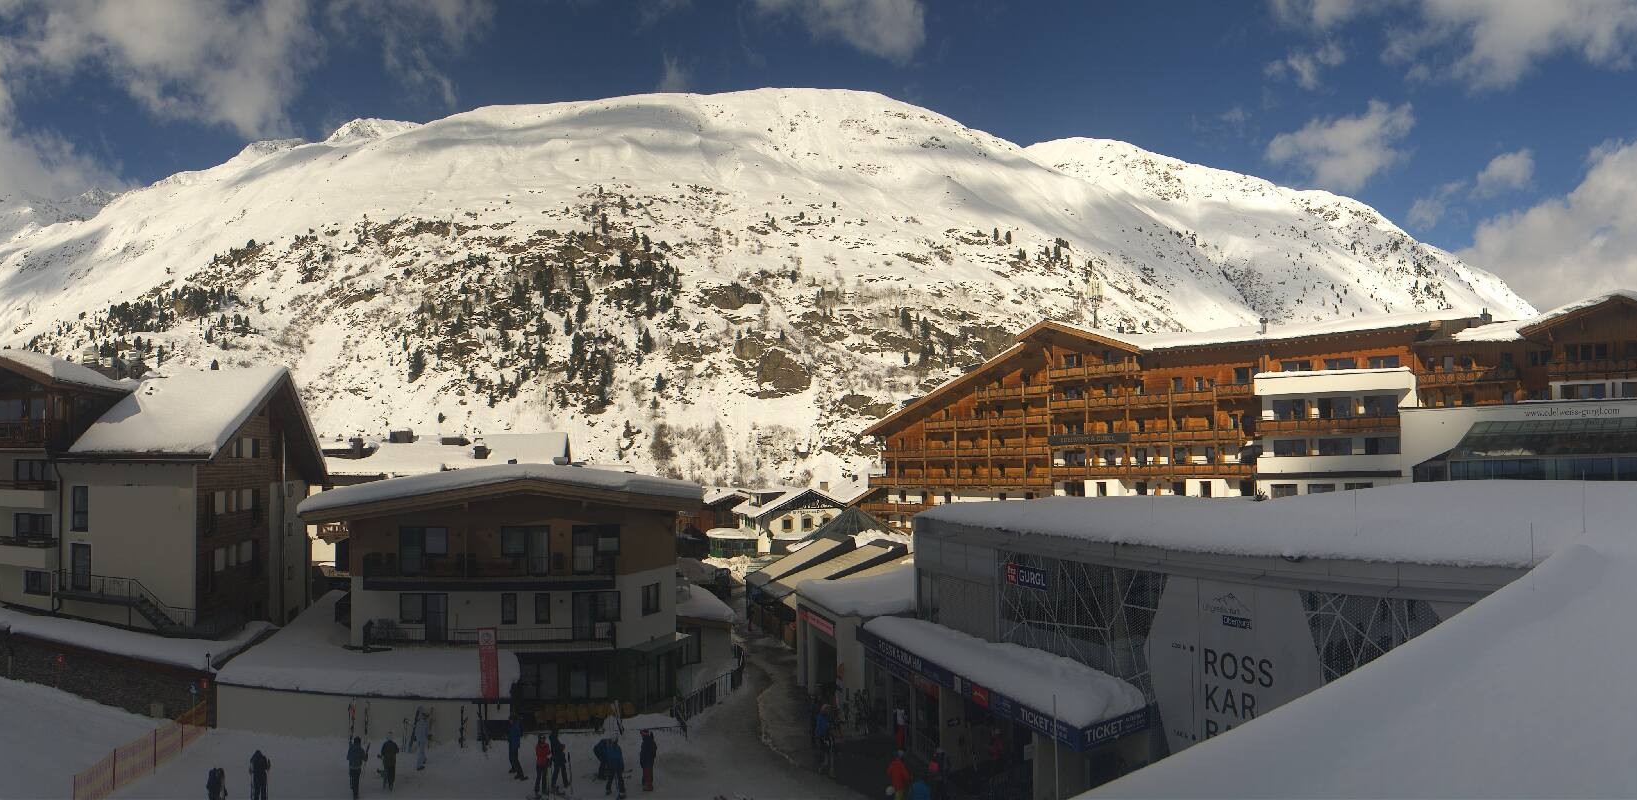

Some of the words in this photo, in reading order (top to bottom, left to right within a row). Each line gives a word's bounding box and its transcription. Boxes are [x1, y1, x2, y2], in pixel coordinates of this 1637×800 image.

[1019, 569, 1046, 587] GURGL
[1204, 648, 1273, 688] ROSS
[1205, 683, 1256, 719] KAR
[1020, 707, 1049, 731] TICKET
[1084, 719, 1124, 743] TICKET
